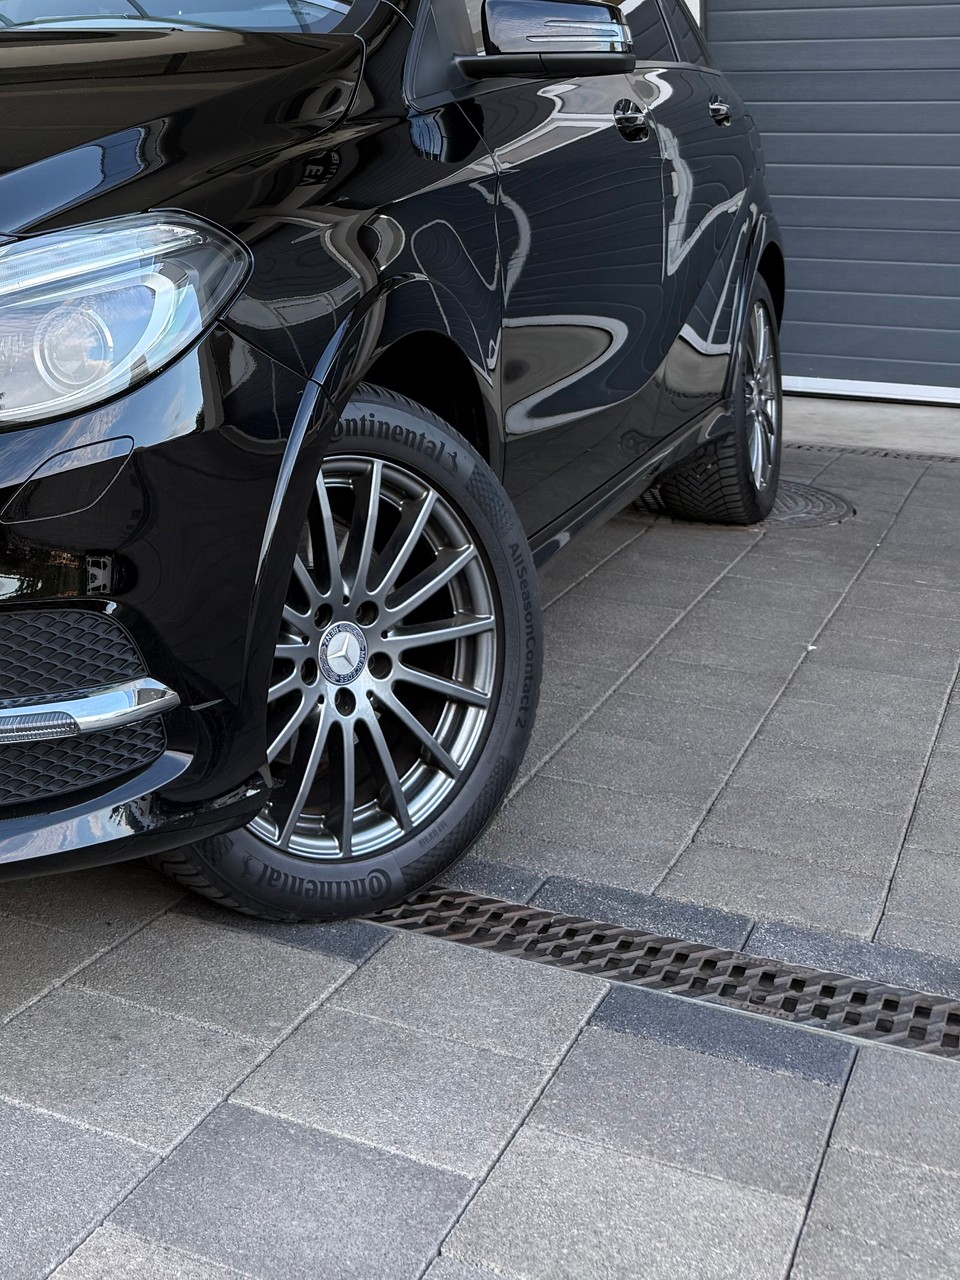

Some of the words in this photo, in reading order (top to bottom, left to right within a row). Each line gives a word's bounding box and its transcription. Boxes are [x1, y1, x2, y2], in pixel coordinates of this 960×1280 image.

[331, 412, 446, 463] ontinental
[508, 542, 537, 713] AllSeasonContact
[256, 862, 393, 901] Continental
